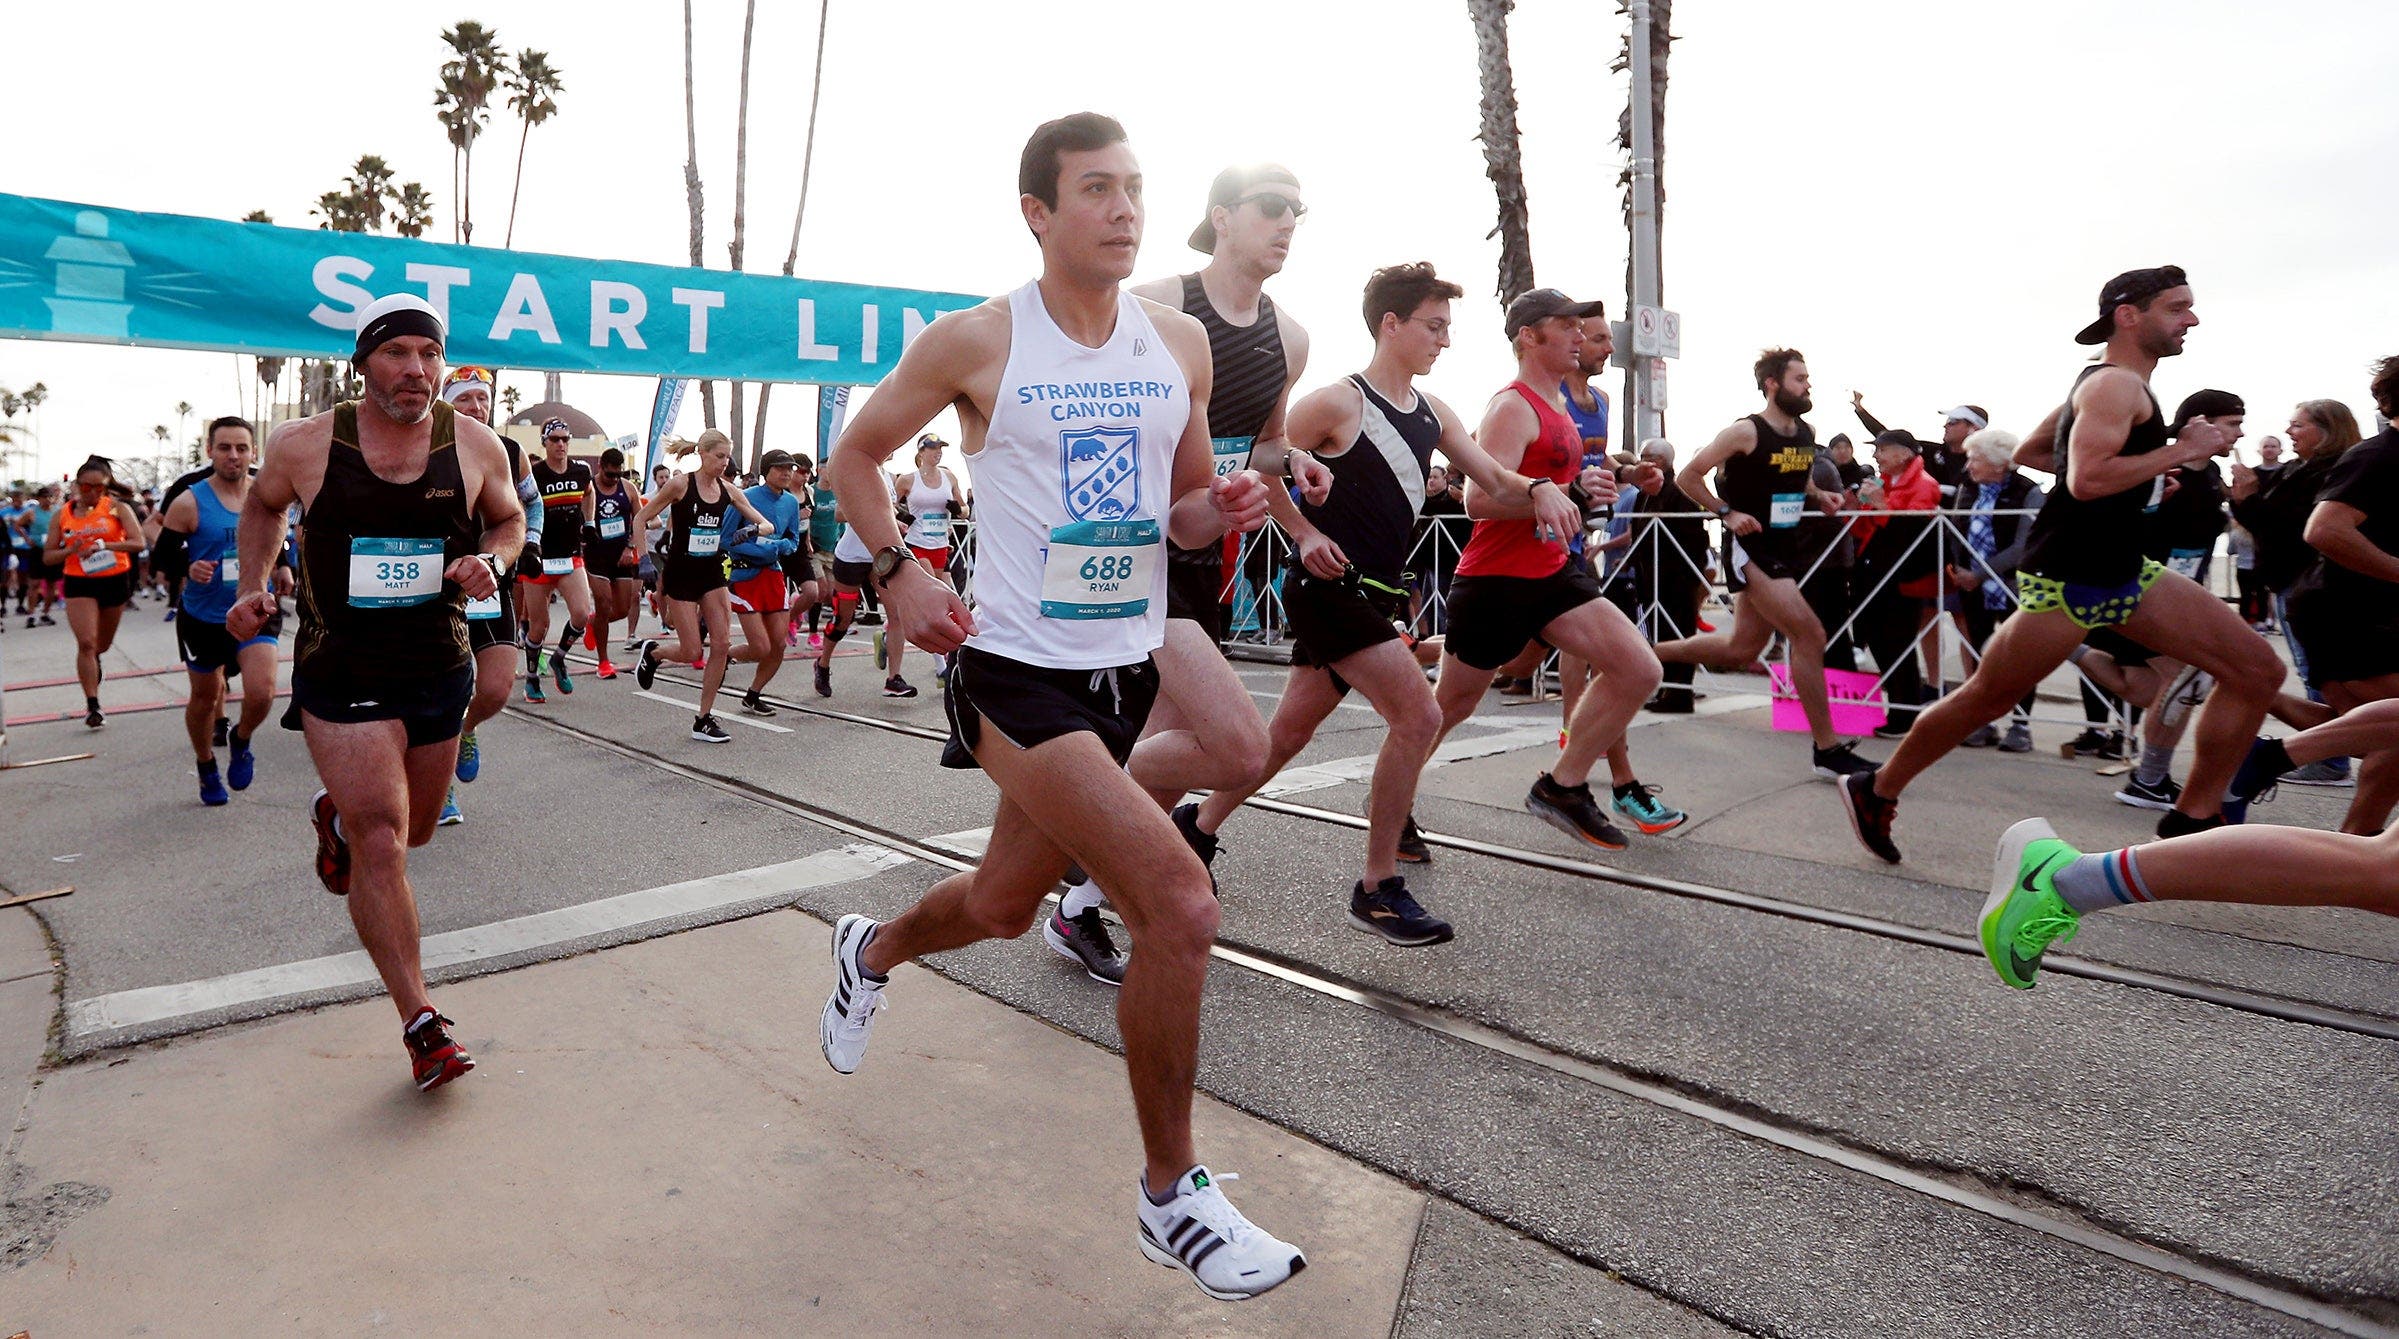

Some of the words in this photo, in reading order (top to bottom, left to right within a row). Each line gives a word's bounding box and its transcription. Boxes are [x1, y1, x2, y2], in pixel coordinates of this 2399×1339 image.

[308, 255, 725, 354] START
[671, 382, 685, 415] PACE
[1017, 381, 1173, 405] STRAWBERRY
[1050, 401, 1141, 422] CANYON
[1213, 459, 1237, 476] 62
[546, 480, 578, 493] nora
[376, 562, 420, 580] 358
[1080, 555, 1133, 580] 688
[385, 581, 410, 589] MATT
[1089, 582, 1119, 592] RYAN
